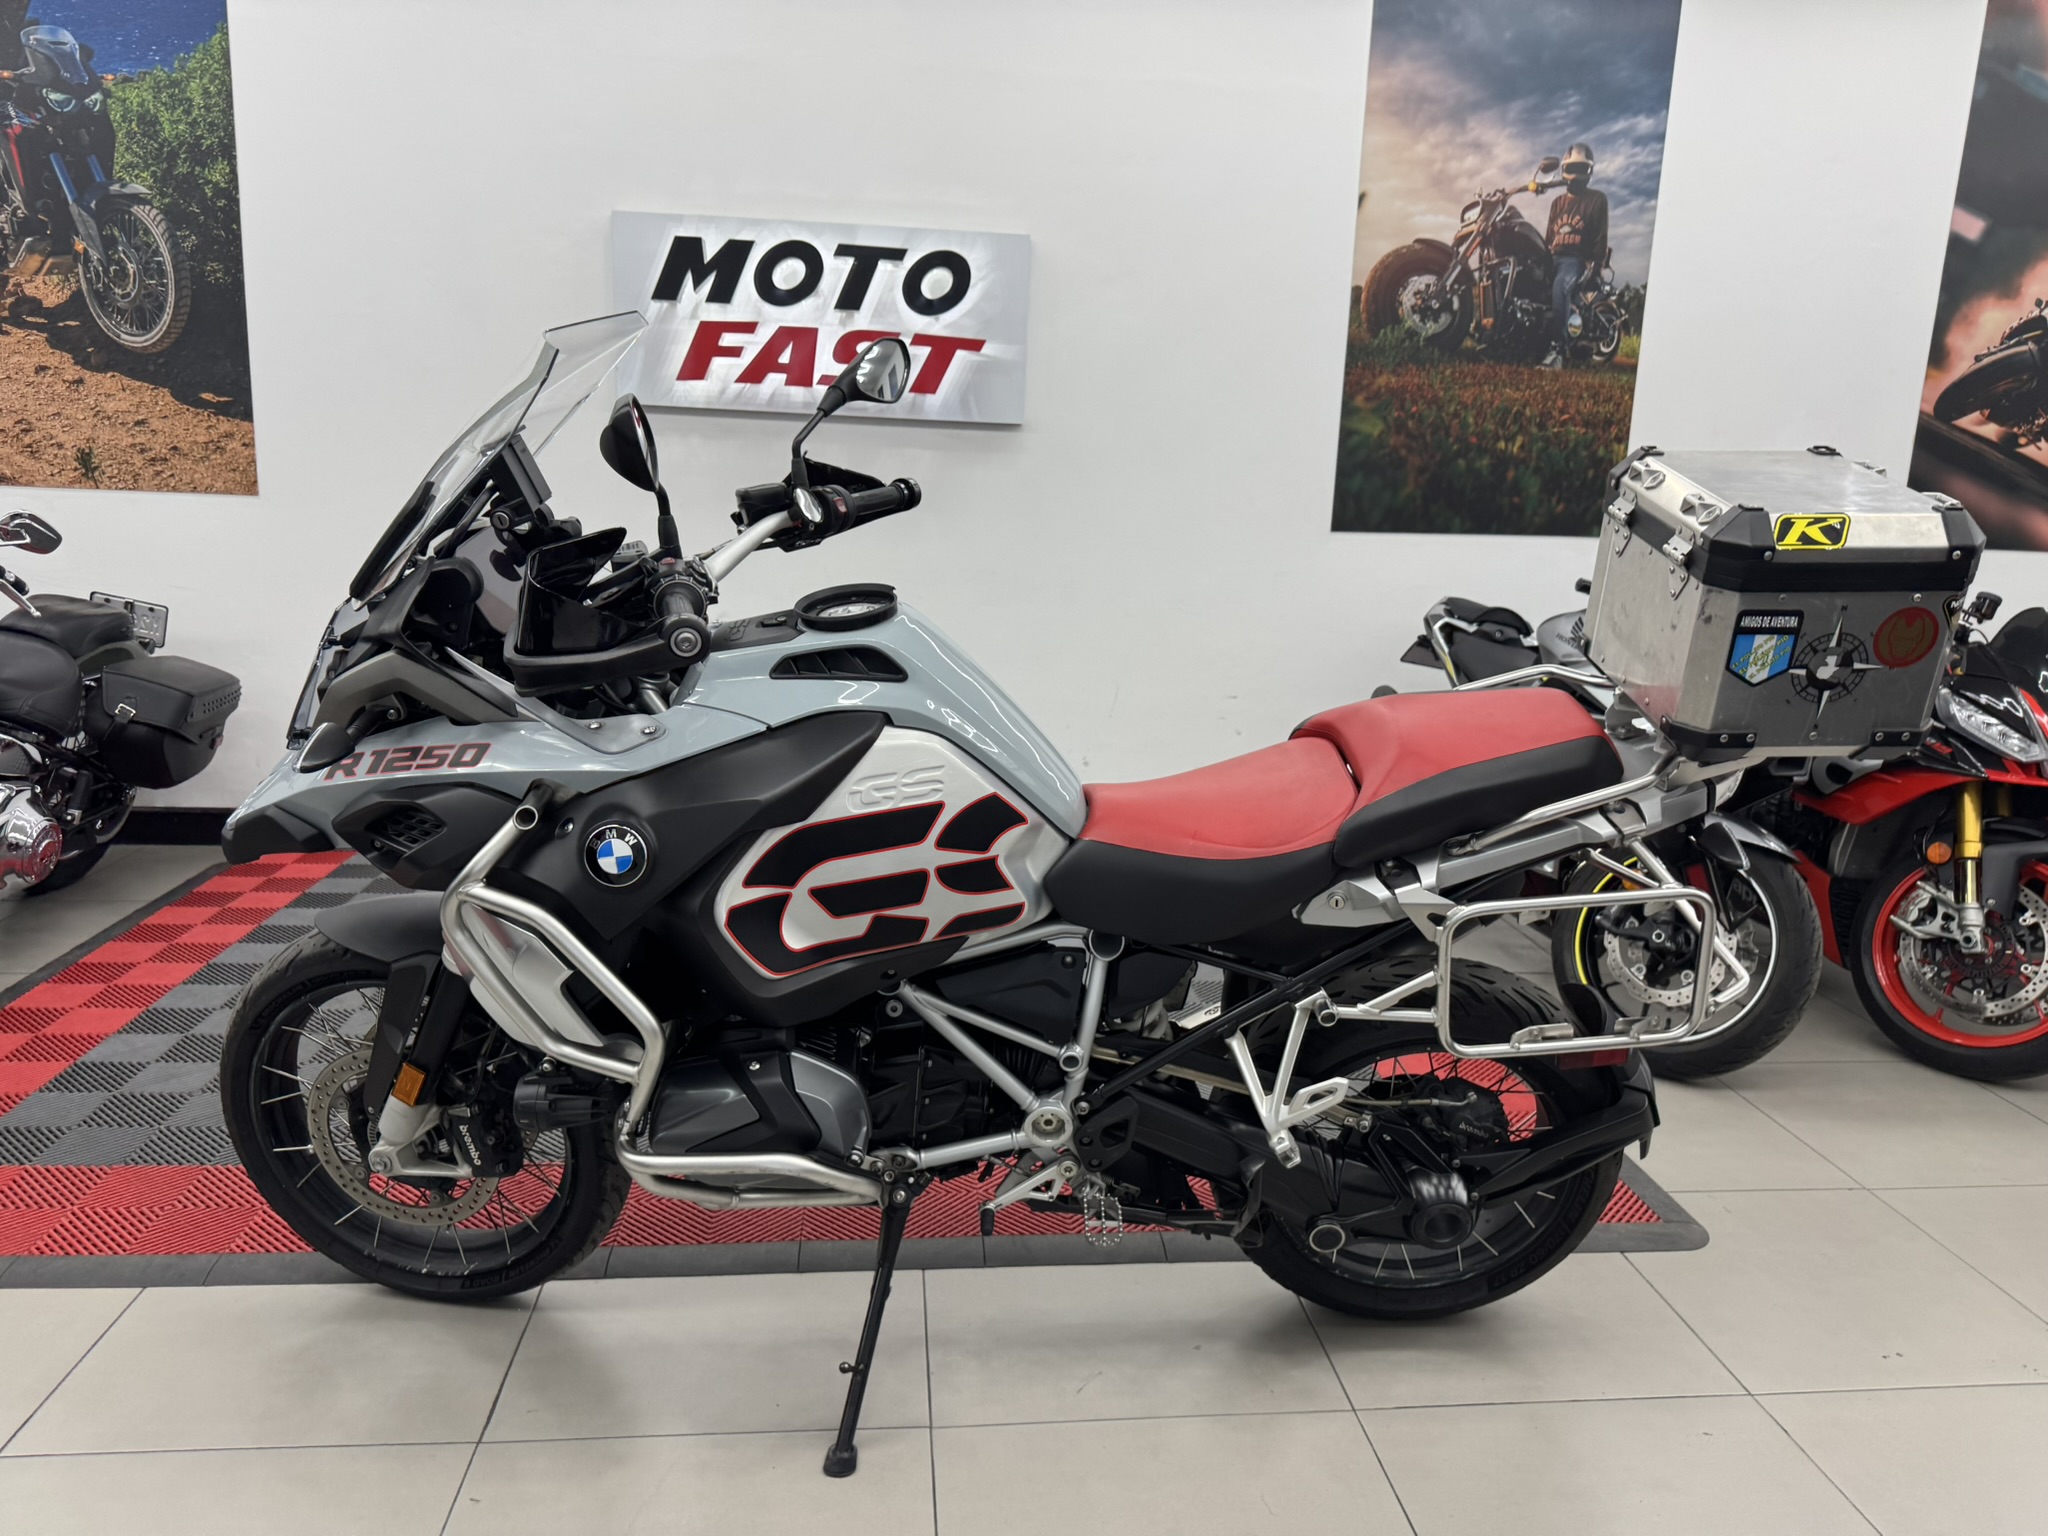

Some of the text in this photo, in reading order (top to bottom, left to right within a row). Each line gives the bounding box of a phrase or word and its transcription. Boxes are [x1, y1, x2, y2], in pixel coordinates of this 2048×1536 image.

[651, 235, 971, 316] MOTO
[676, 321, 986, 396] FAST
[1778, 518, 1843, 545] K
[1740, 615, 1799, 628] AMIGOS DE AVENTURA
[323, 742, 492, 782] R 1250
[846, 765, 945, 813] GS
[589, 828, 638, 850] BMW
[459, 1124, 482, 1166] brembo
